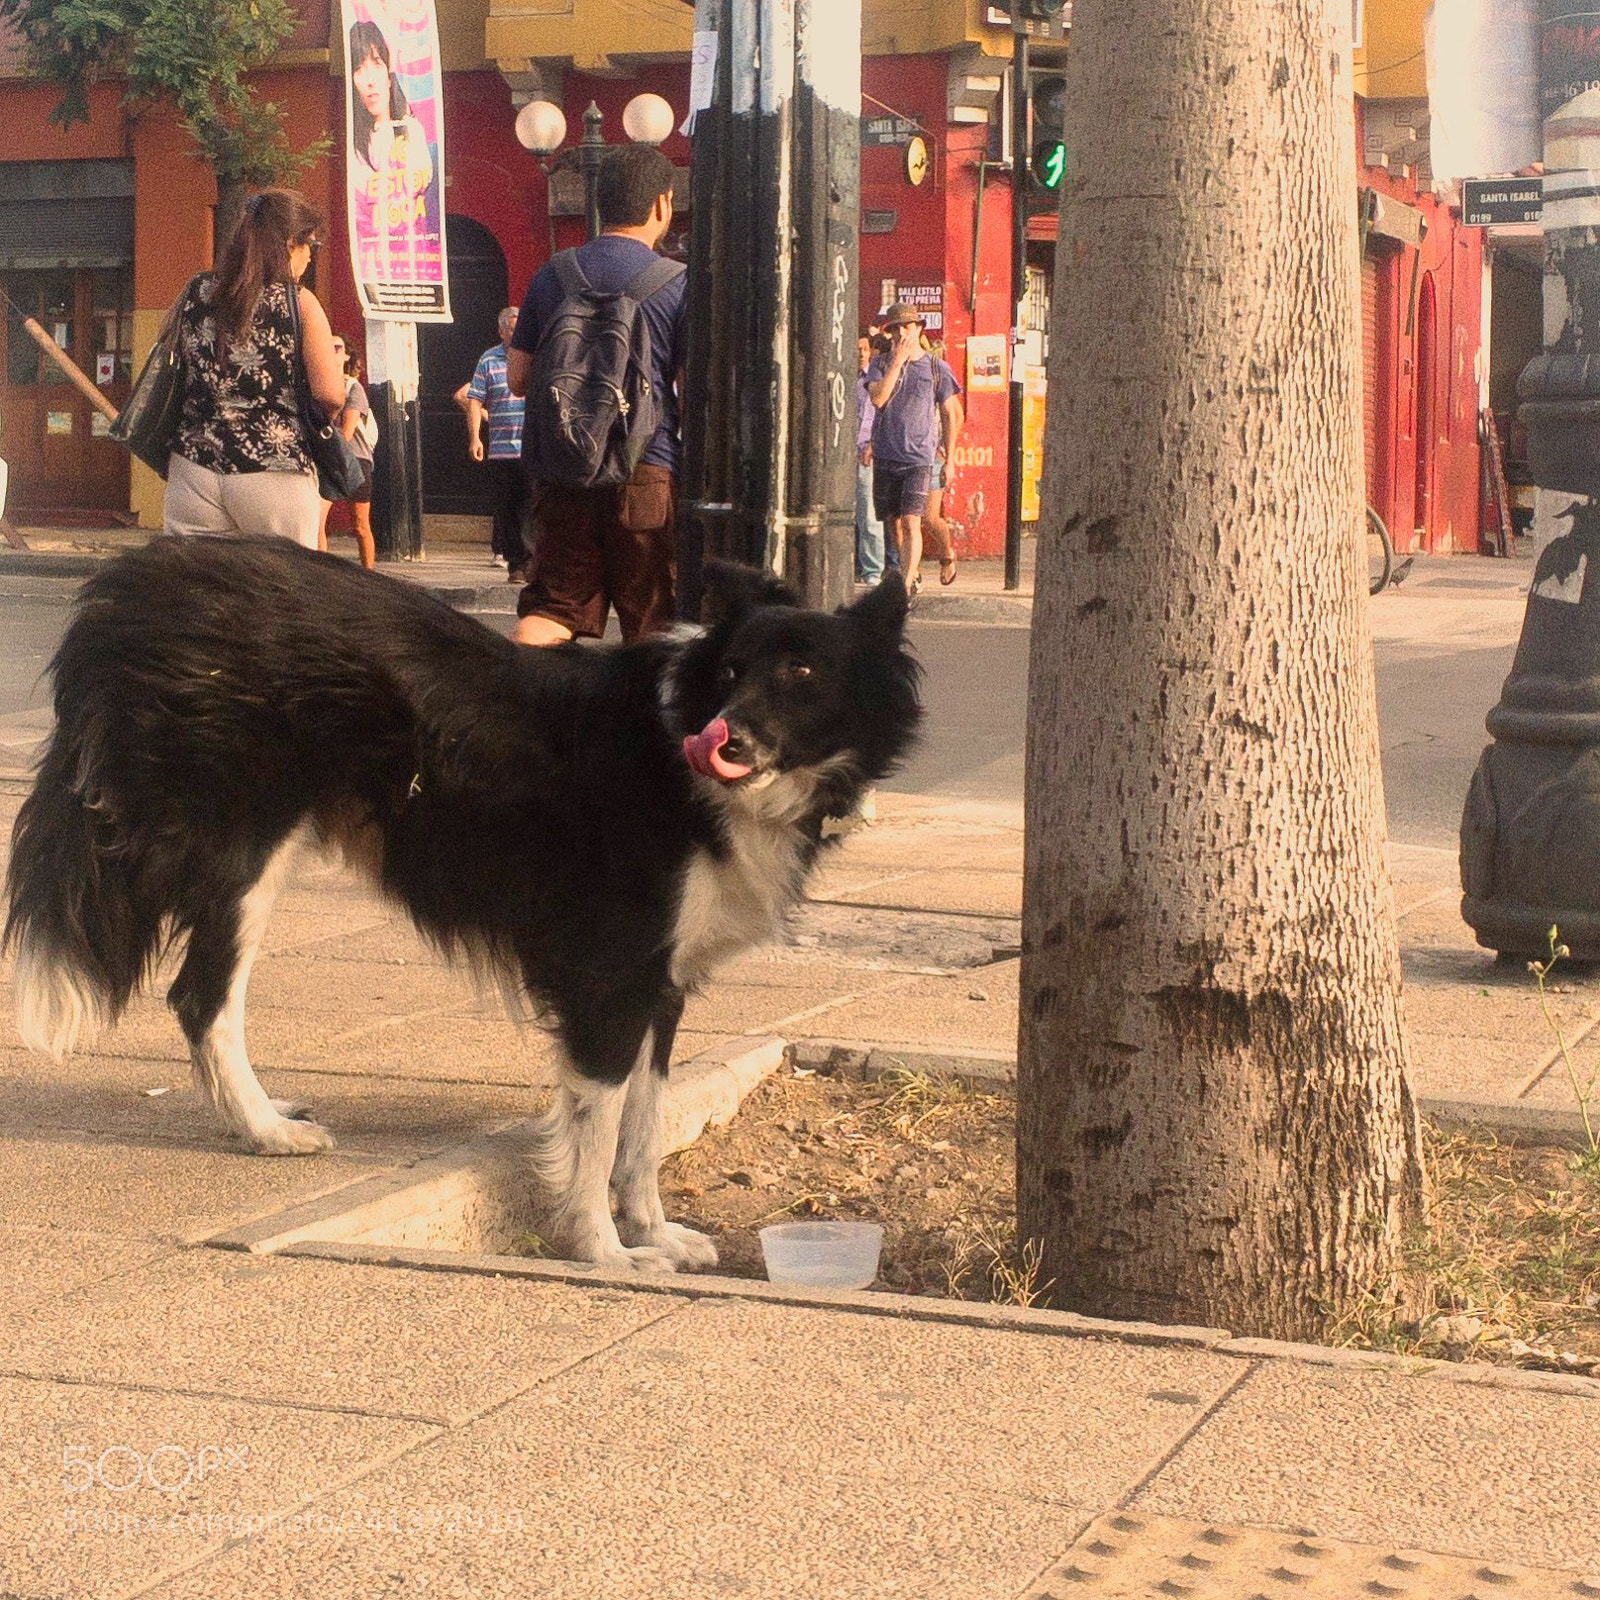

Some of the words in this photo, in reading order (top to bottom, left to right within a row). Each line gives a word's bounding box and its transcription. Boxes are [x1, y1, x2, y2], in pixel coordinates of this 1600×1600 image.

[1480, 193, 1508, 204] SANTA
[1509, 191, 1540, 202] ISABEL
[1470, 213, 1492, 223] 0199
[898, 287, 916, 296] DALE
[917, 286, 942, 296] ESTILO
[915, 295, 941, 304] PREVIA
